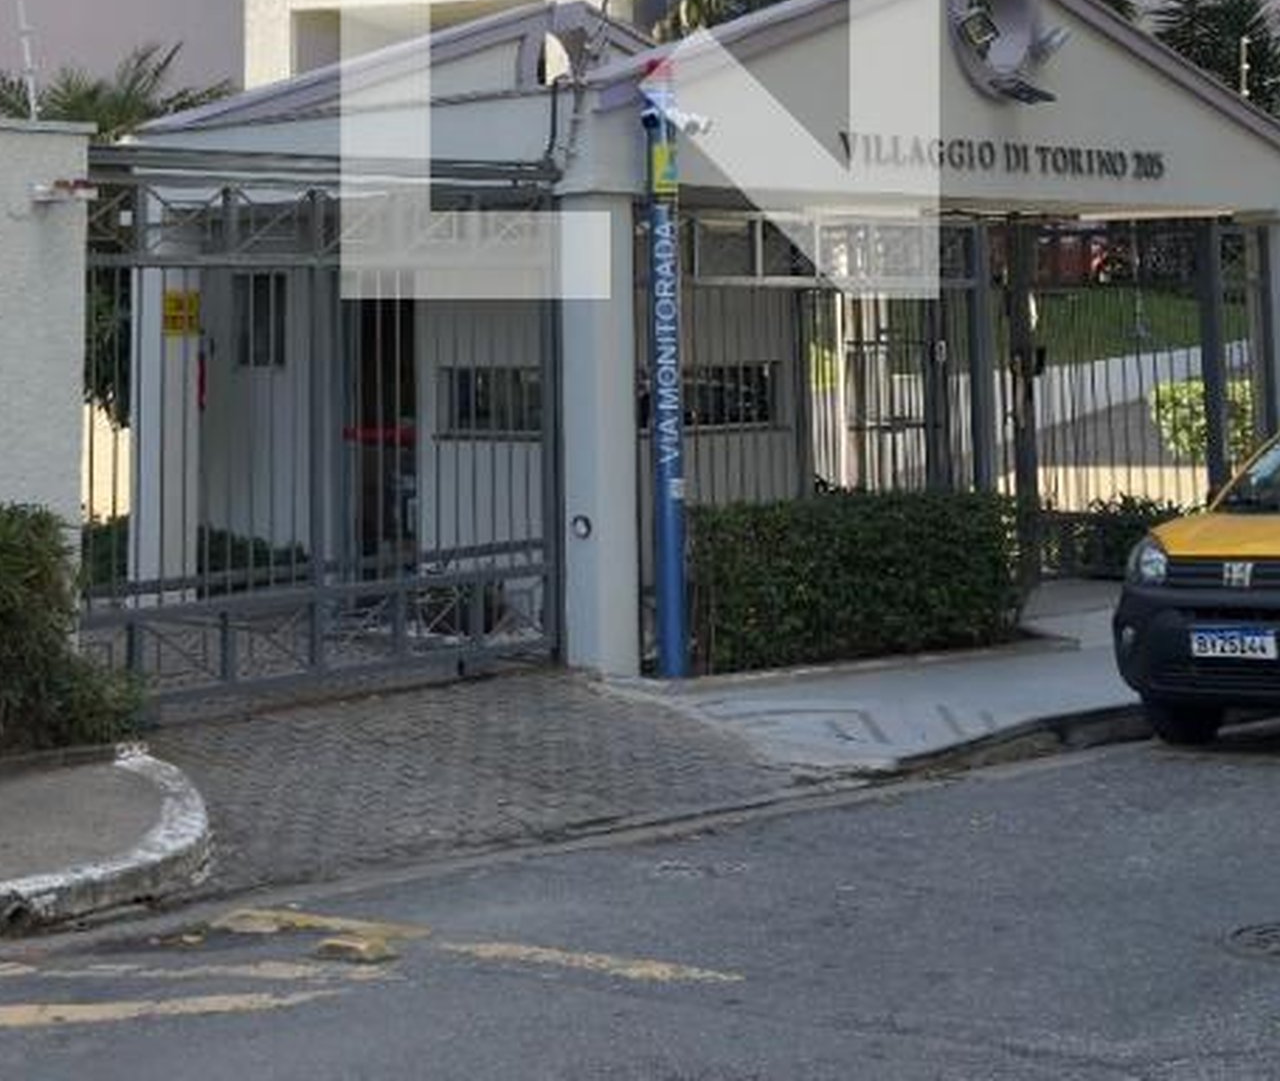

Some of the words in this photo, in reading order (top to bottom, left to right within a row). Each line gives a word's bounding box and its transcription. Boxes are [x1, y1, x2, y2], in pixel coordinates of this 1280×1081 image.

[838, 131, 996, 172] VILLAGGIO
[1004, 141, 1028, 174] DI
[1037, 146, 1127, 178] TORINO
[655, 221, 679, 409] MONITORADA
[660, 415, 680, 463] VIA
